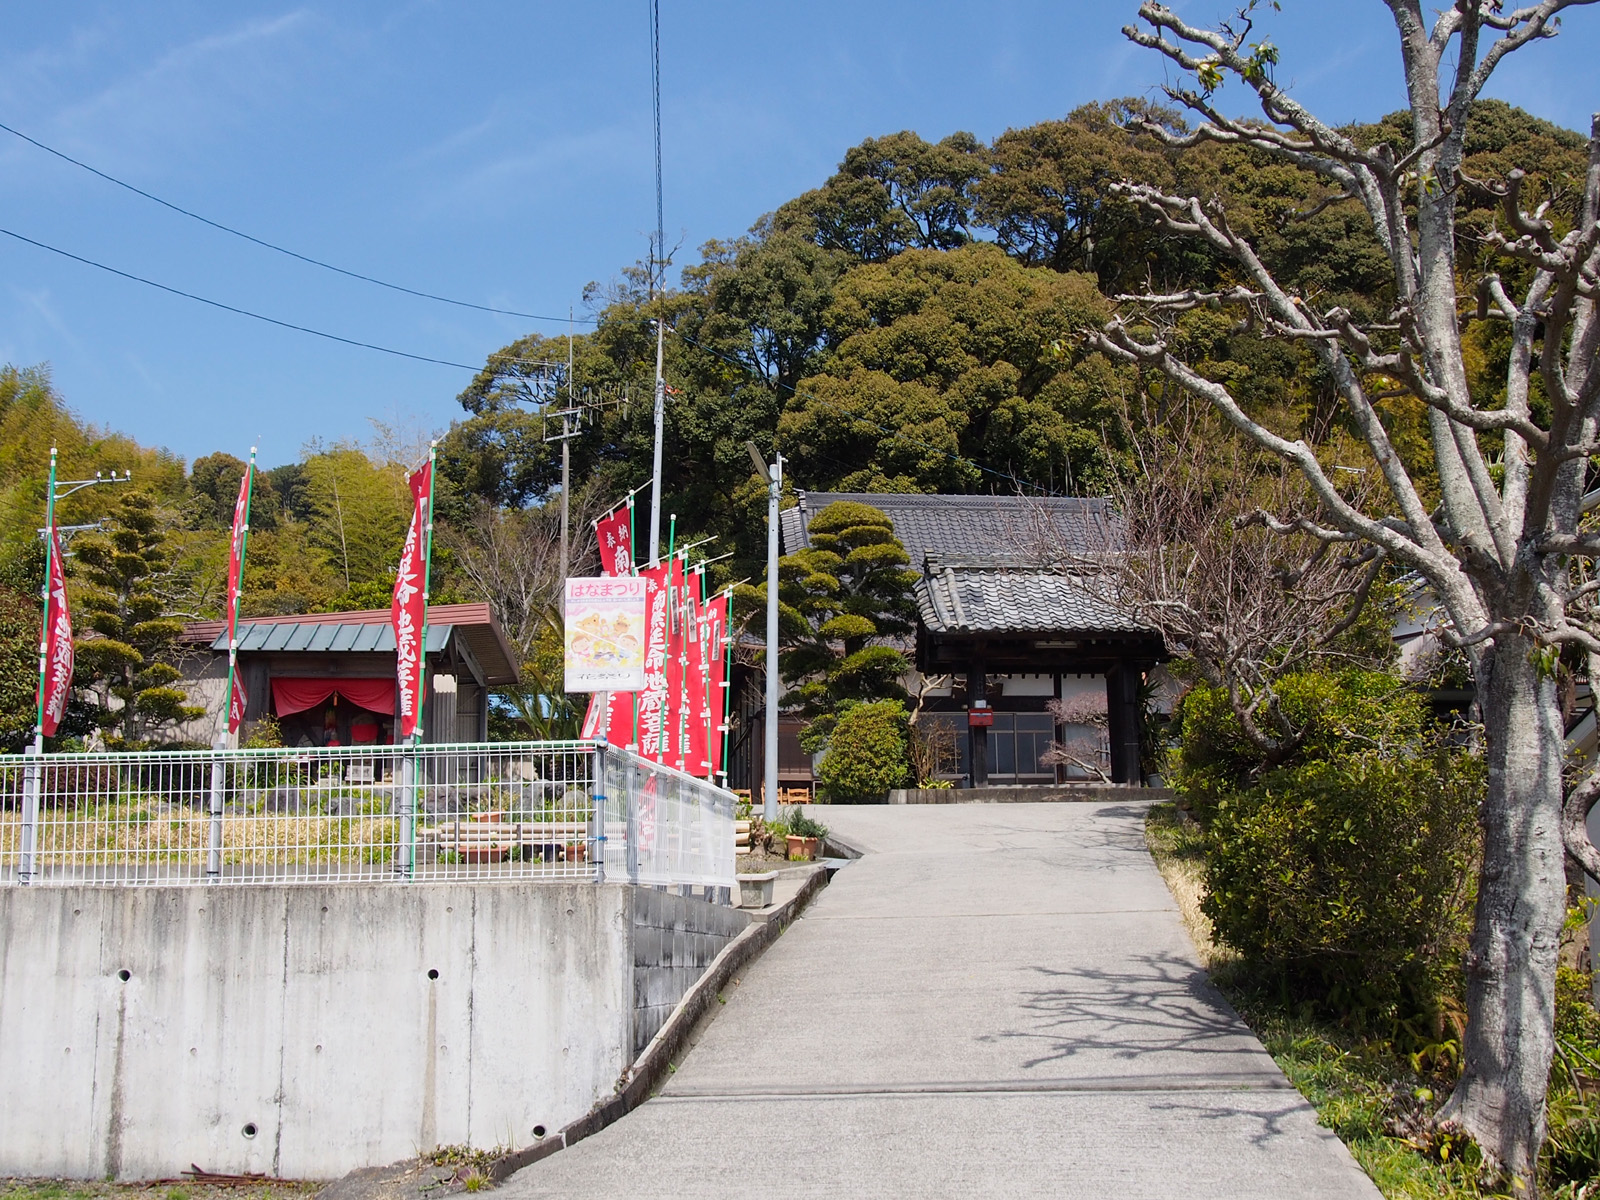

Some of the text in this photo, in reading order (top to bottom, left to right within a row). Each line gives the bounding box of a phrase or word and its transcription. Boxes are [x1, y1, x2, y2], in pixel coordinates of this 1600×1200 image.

[606, 524, 629, 548] 奉納
[570, 581, 640, 598] はなまつり
